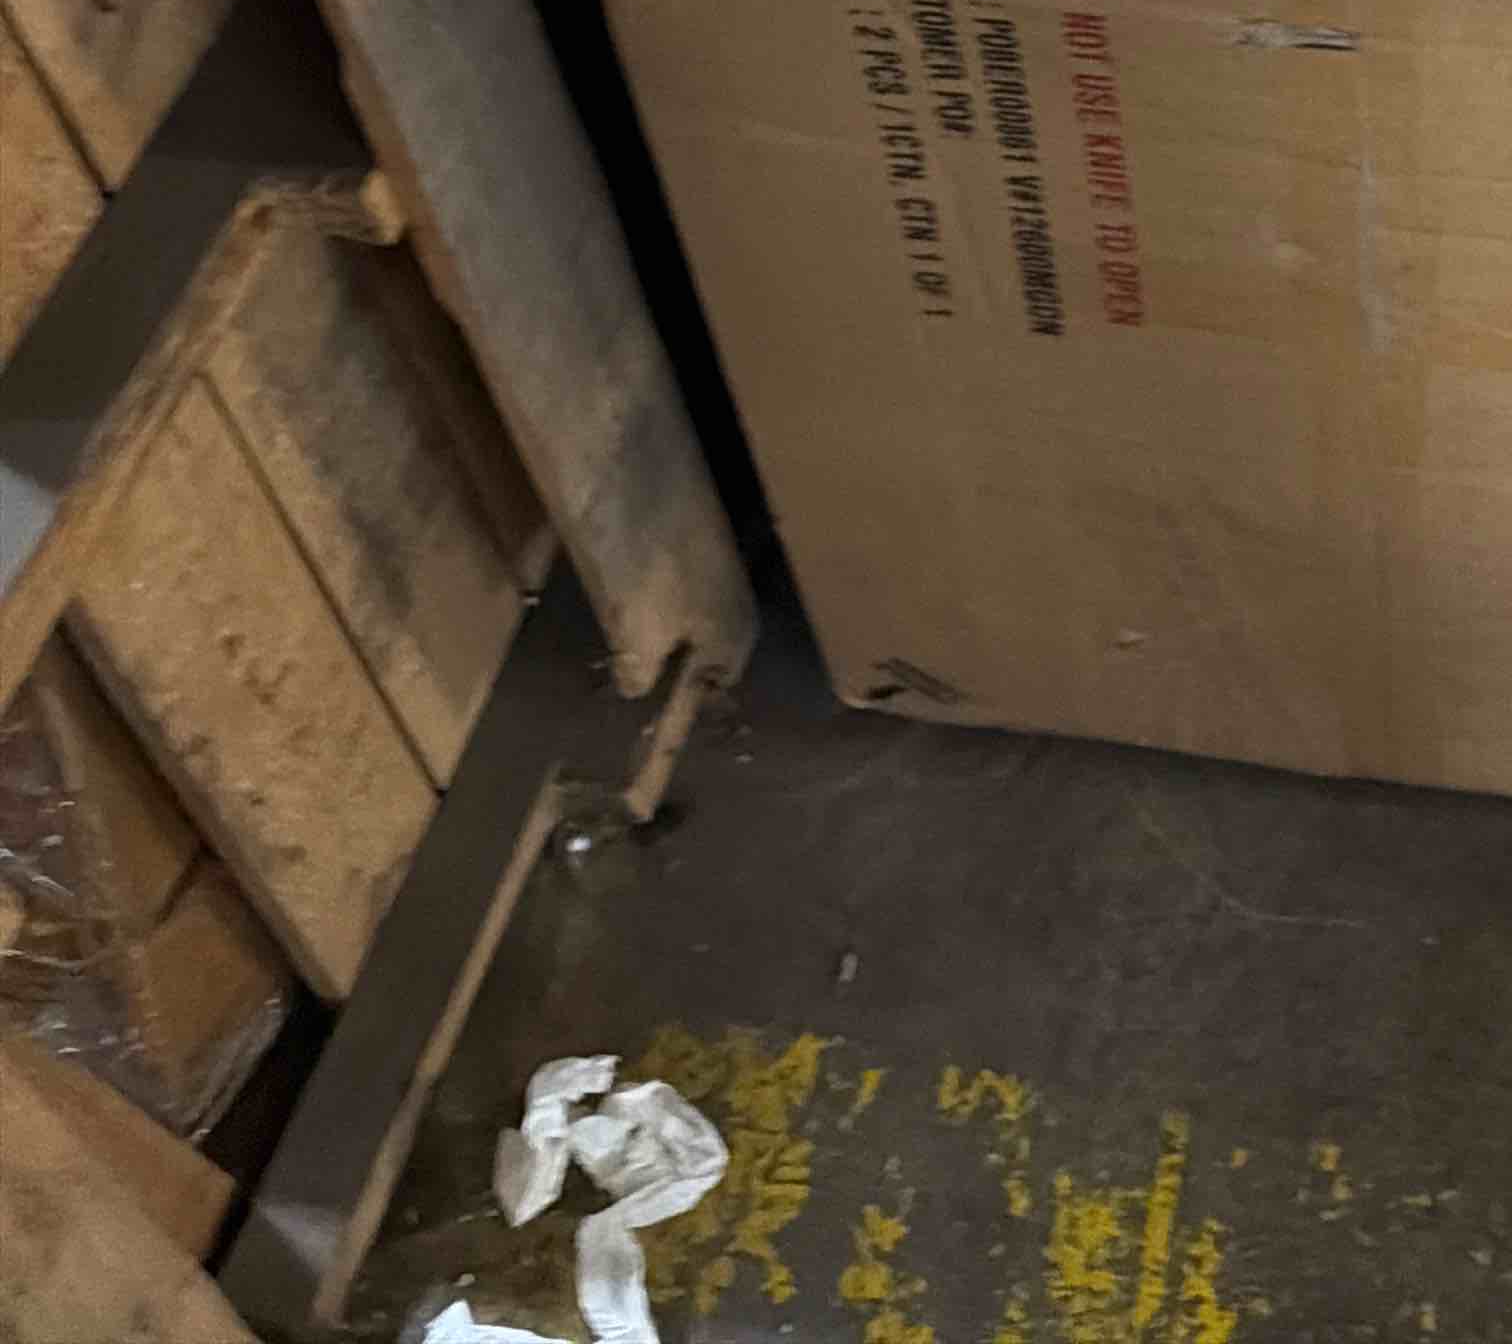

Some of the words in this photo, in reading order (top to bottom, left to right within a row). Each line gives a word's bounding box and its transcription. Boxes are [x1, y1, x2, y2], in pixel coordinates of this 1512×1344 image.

[1061, 12, 1113, 63] NOT
[1071, 73, 1121, 123] USE
[859, 48, 910, 96] PCS
[895, 196, 940, 242] CTN
[1083, 133, 1133, 209] KNIFE
[1093, 223, 1137, 252] TO
[1097, 259, 1146, 329] OPEN
